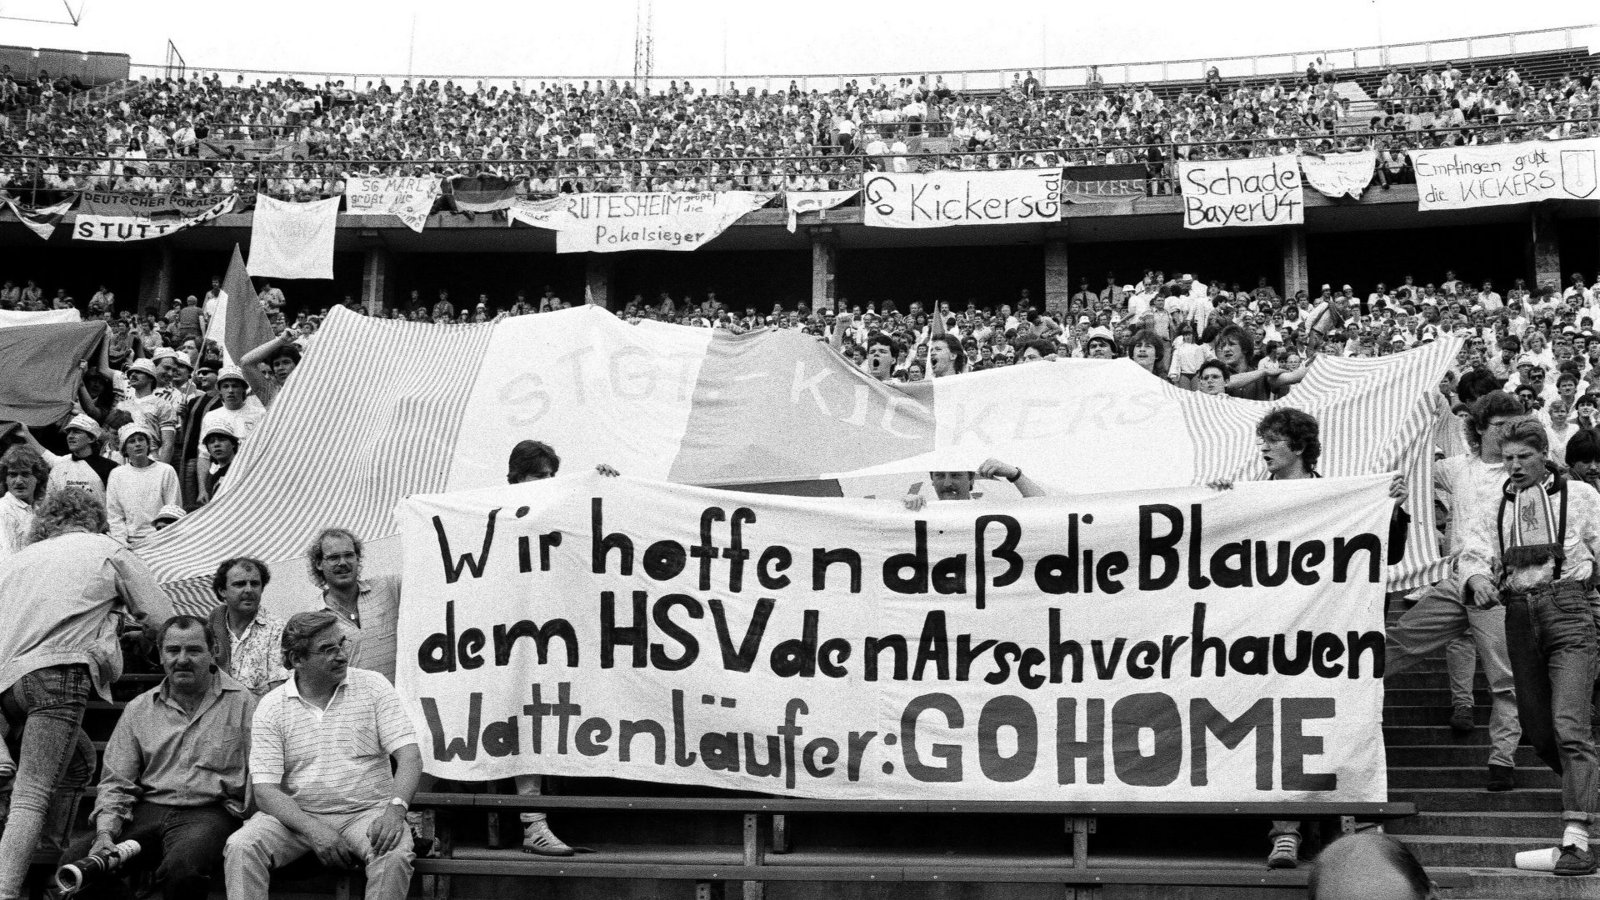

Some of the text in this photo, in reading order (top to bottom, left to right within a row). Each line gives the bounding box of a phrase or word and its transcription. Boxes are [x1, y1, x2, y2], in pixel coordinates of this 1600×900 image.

[361, 181, 379, 192] SG
[1186, 162, 1299, 195] Schade
[1425, 170, 1556, 203] die KICKERS
[84, 192, 165, 207] DEUTSCHER
[911, 180, 1033, 222] Kickers
[78, 221, 170, 240] STUTT
[596, 225, 705, 246] Pokalsieger
[432, 498, 1382, 609] Wir hoffen daß die Blauen
[418, 591, 1386, 690] dem HSV den Arsch verhauen
[420, 682, 1340, 791] Wattenläufer: GO HOME
